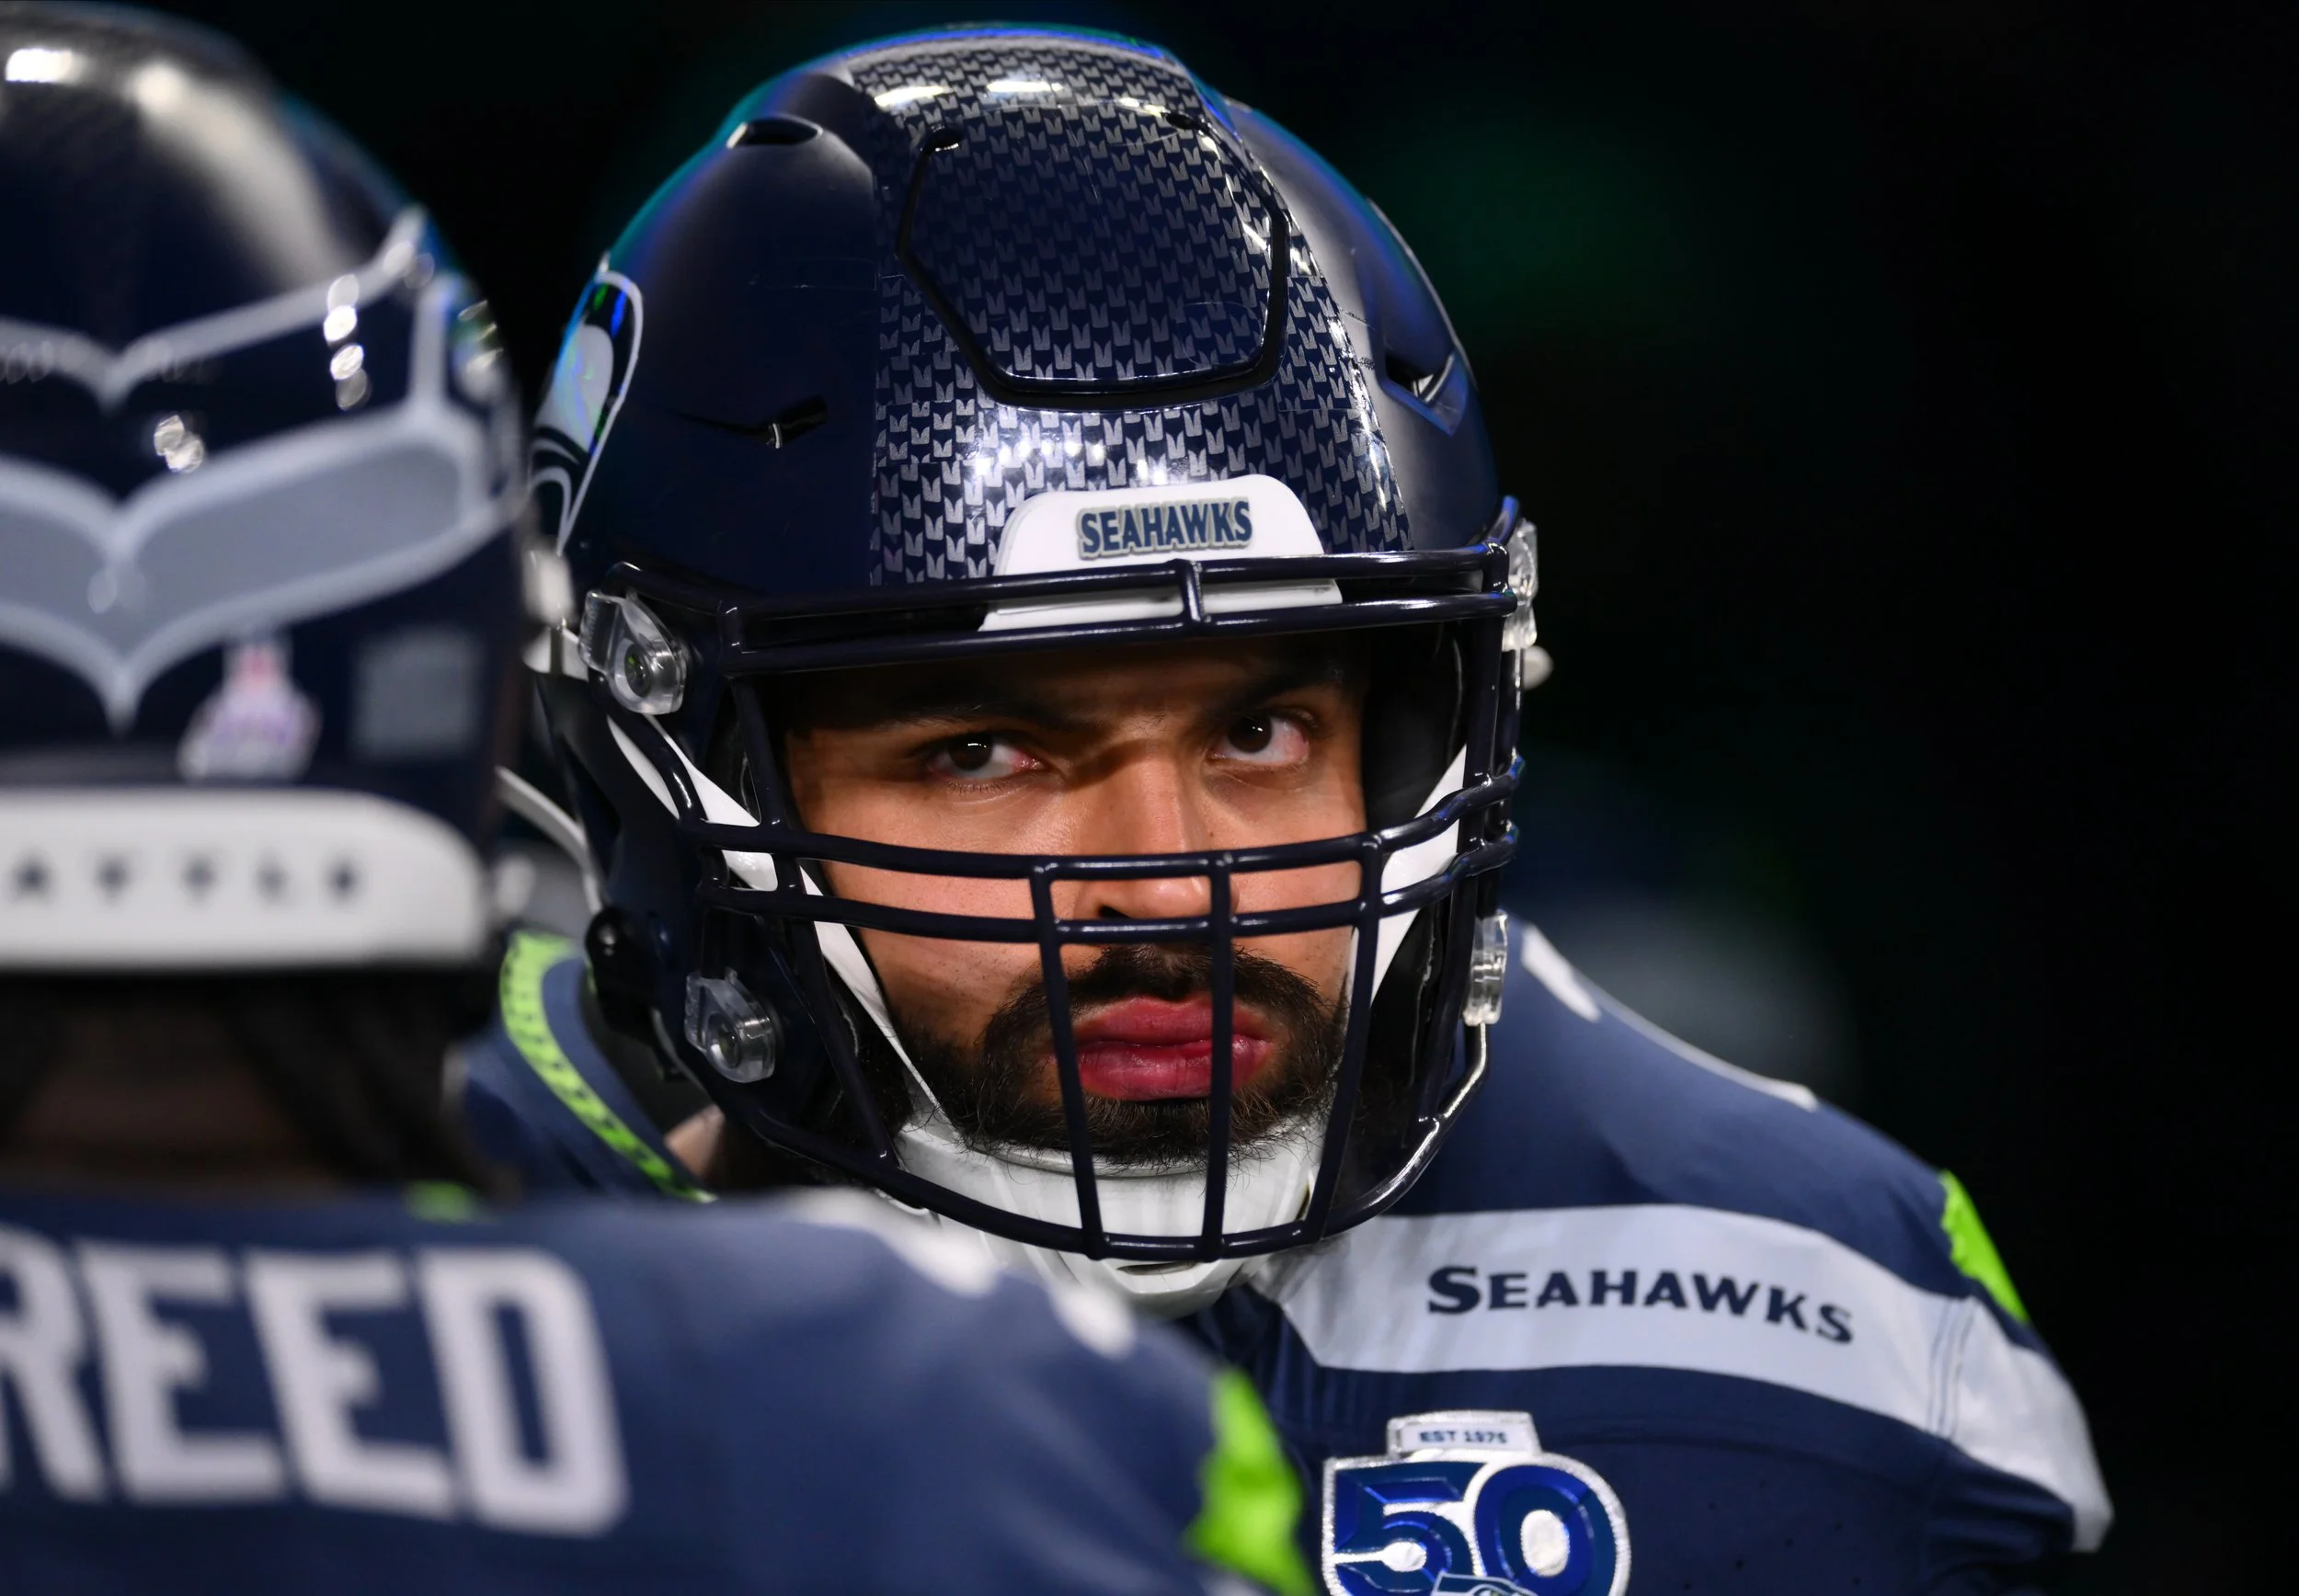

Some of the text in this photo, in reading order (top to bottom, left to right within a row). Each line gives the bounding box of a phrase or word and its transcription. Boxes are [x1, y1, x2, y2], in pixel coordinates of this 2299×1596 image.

[1079, 499, 1253, 556] SEAHAWKS
[1427, 1265, 1854, 1344] SEAHAWKS
[0, 1225, 629, 1537] REED
[1419, 1430, 1457, 1443] EST
[1333, 1460, 1618, 1596] 50
